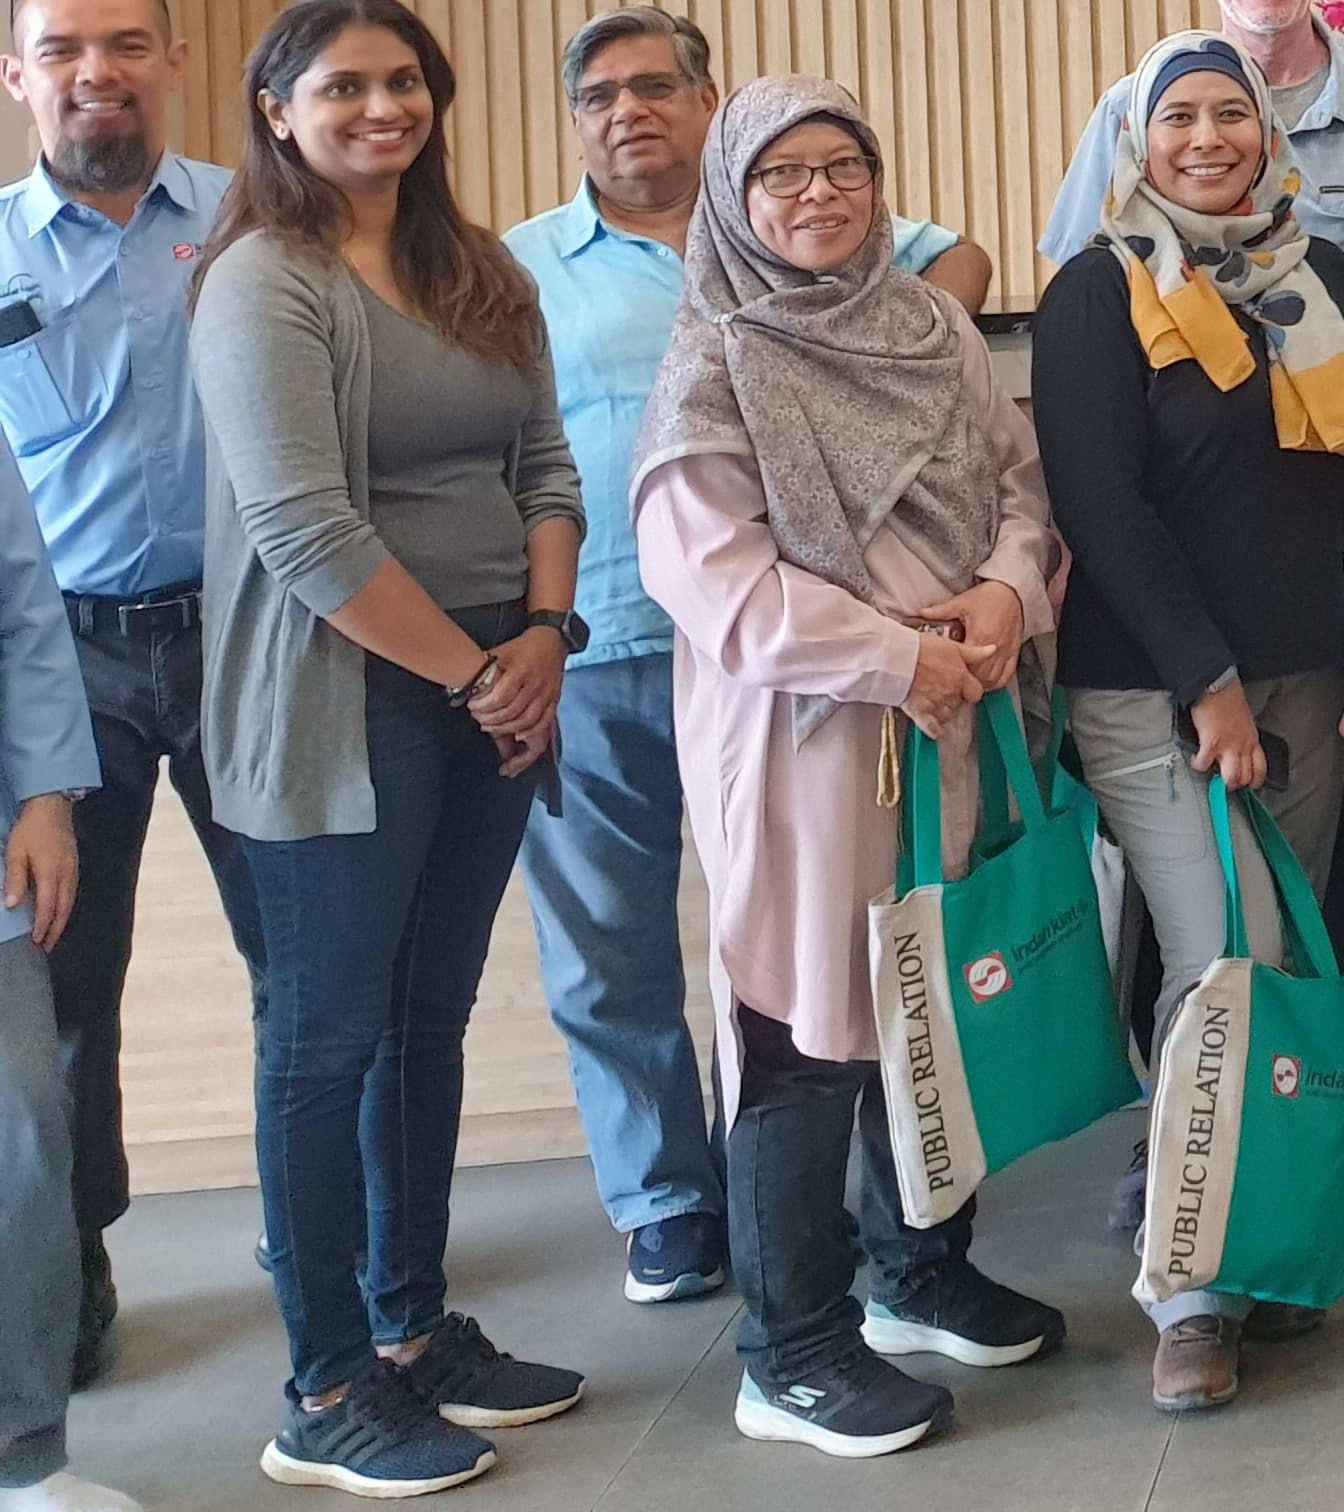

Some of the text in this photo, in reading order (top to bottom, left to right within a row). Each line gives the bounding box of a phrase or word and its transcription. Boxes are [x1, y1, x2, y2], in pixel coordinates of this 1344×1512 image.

[895, 932, 954, 1194] PUBLIC RELATION
[1168, 1004, 1230, 1279] PUBLIC RELATION
